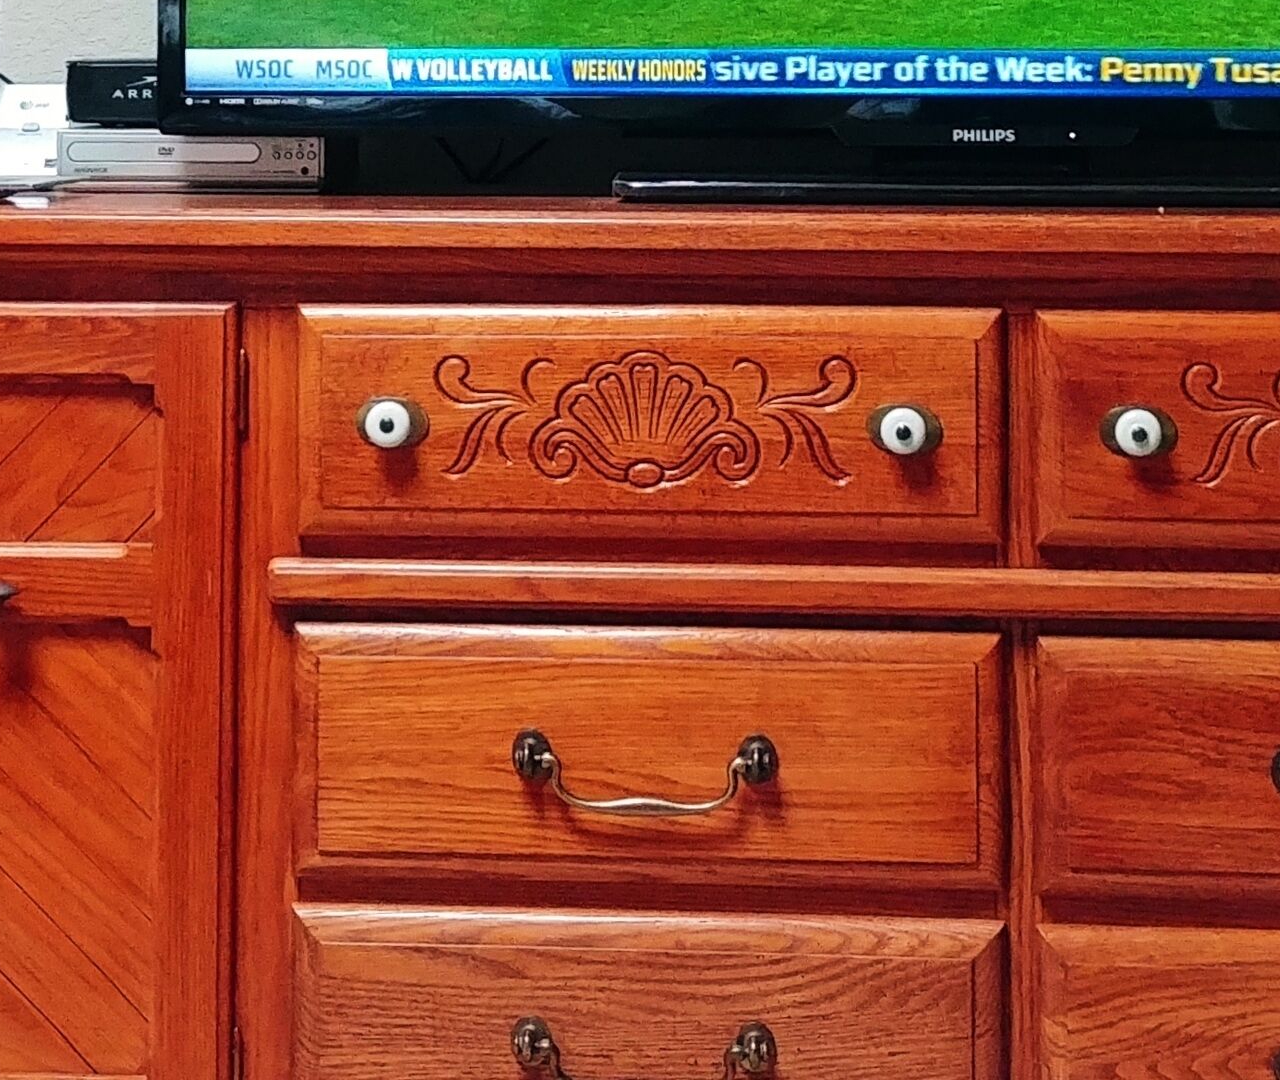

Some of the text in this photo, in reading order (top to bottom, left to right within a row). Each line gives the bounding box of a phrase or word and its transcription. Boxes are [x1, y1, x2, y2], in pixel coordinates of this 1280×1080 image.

[236, 59, 552, 82] WSOC MSOC W VOLLEYBALL
[572, 59, 706, 82] WEEKLY HONORS
[711, 56, 777, 82] sive
[785, 57, 887, 87] Player
[895, 56, 927, 82] of
[934, 57, 988, 82] the
[997, 58, 1093, 82] Week:
[1101, 58, 1202, 89] Penny
[111, 88, 154, 99] ARR
[953, 129, 1016, 142] PHILIPS
